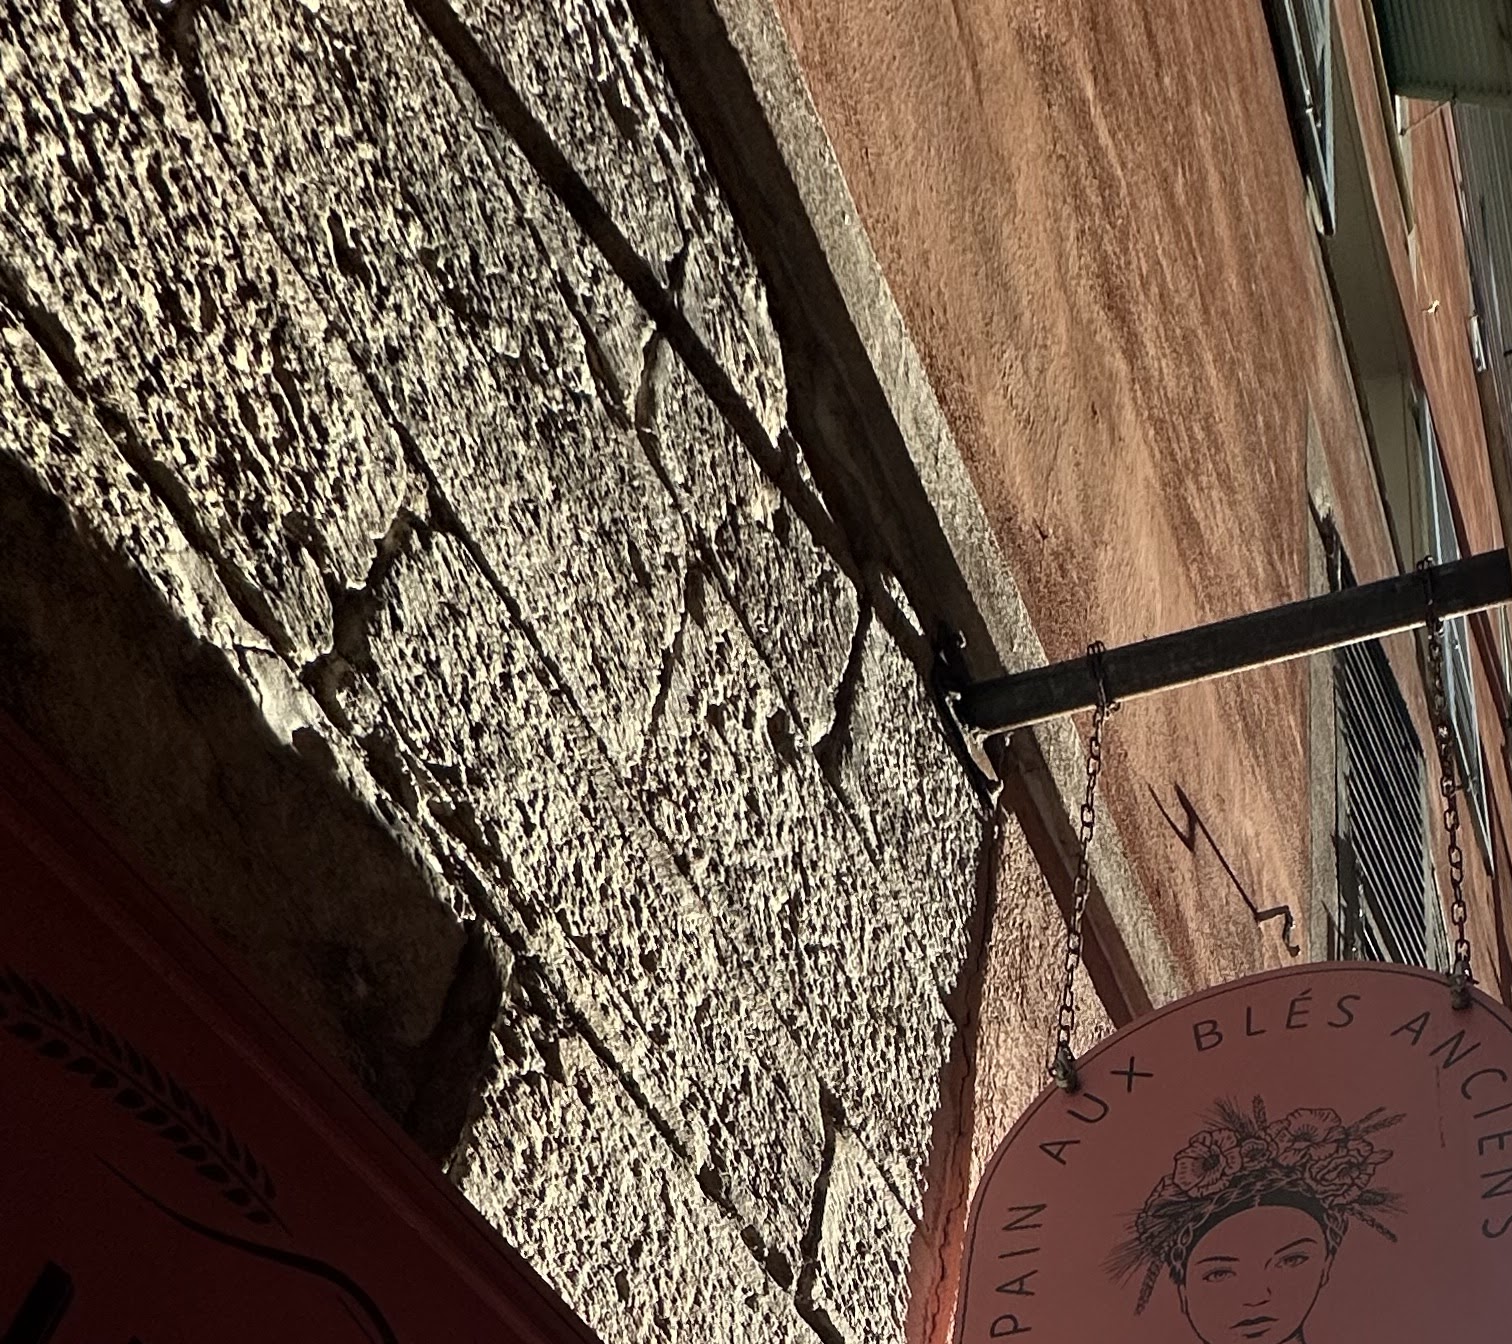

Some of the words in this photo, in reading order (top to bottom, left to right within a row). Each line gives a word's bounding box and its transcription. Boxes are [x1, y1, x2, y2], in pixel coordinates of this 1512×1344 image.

[989, 1200, 1047, 1339] PAIN
[1038, 1055, 1154, 1167] AUX
[1191, 992, 1362, 1052] BLÉS
